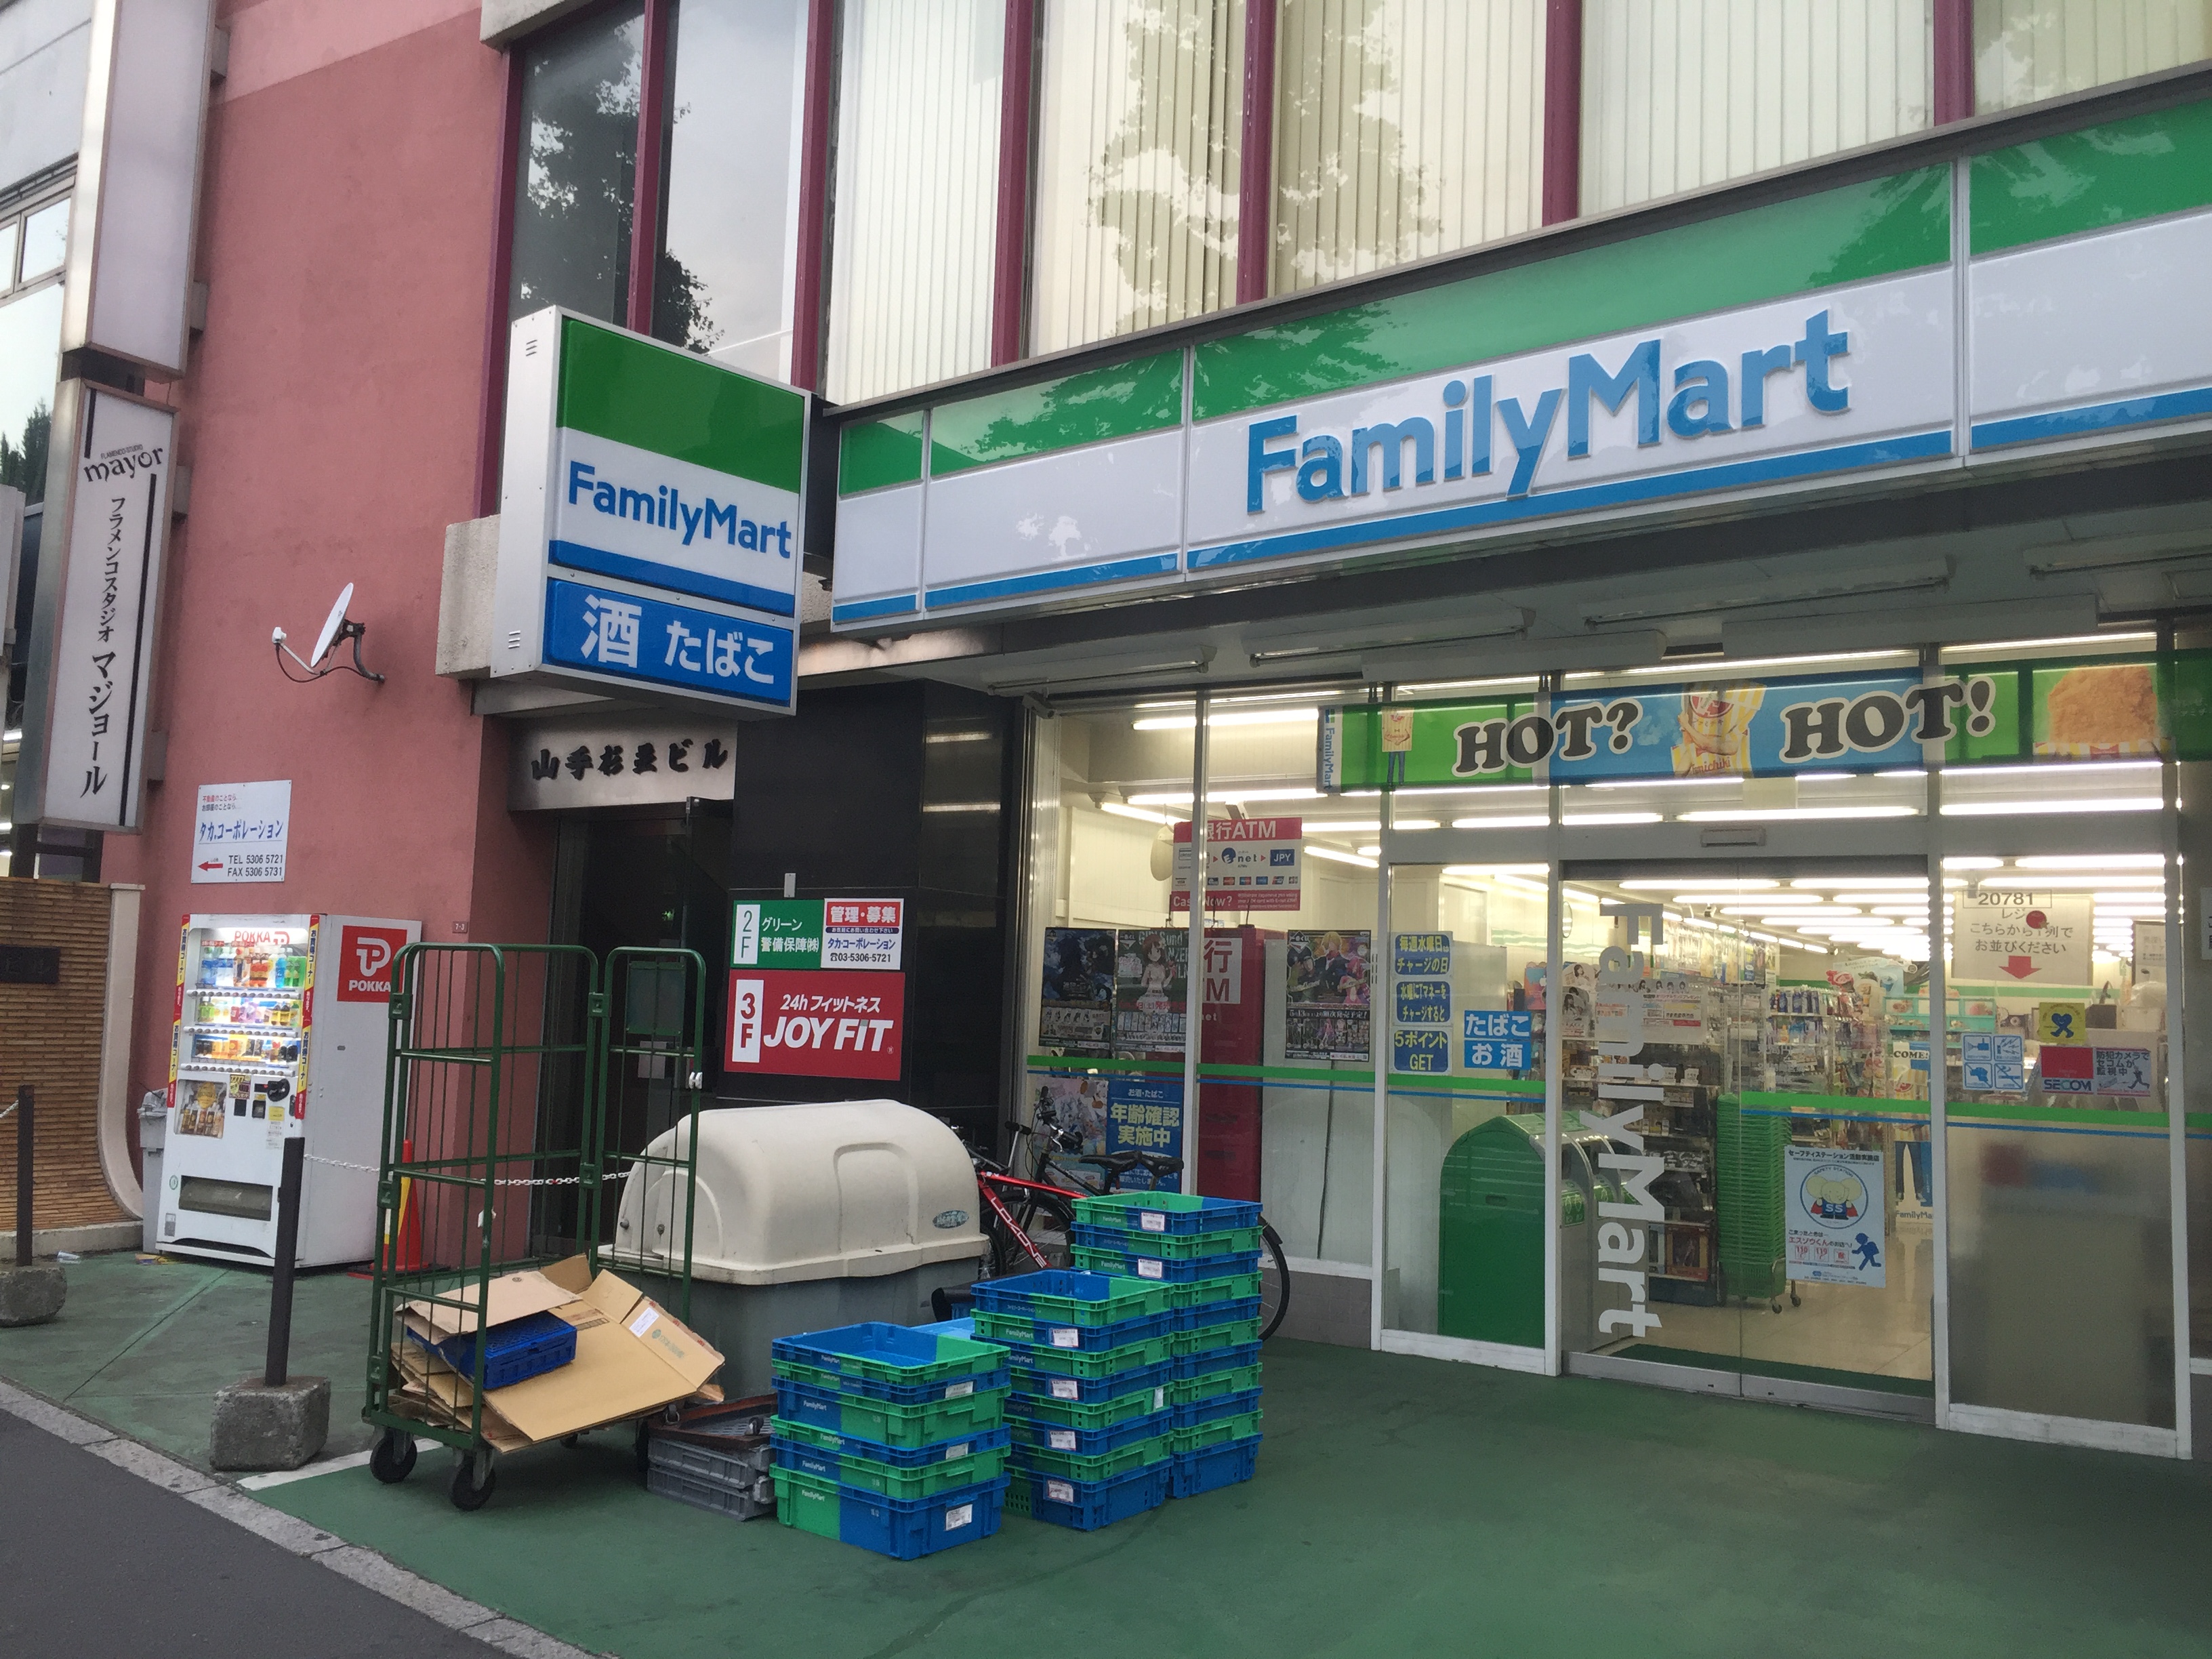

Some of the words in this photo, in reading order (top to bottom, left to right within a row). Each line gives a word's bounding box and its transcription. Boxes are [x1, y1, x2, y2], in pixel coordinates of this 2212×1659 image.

[1247, 309, 1849, 498] FamilyMart
[83, 448, 163, 482] mayor
[568, 460, 792, 558] FamilyMart
[97, 497, 127, 642] フラメンコスタジオ
[581, 594, 642, 668] 酒
[664, 620, 775, 684] たばこ
[80, 651, 117, 798] マジョール
[1784, 680, 1990, 758] HOT!
[1454, 703, 1640, 773] HOT?
[1324, 727, 1336, 790] FamilyMart
[229, 855, 243, 864] TEL
[246, 855, 263, 864] 5306
[266, 855, 283, 864] 5721
[1273, 853, 1291, 863] JPY
[228, 867, 243, 877] FAX
[245, 867, 263, 877] 5306
[264, 867, 282, 877] 5731
[1173, 896, 1191, 907] Cas
[1978, 892, 2034, 905] 20781
[830, 905, 897, 924] 管理・募集
[762, 917, 802, 931] グリーン
[234, 930, 270, 943] POKKA
[1975, 939, 2066, 954] お並びください
[838, 952, 891, 962] 03-5306-5721
[1204, 939, 1233, 973] 行
[1397, 958, 1448, 973] チャージの日
[348, 979, 391, 992] POKKA
[780, 994, 808, 1010] 24h
[811, 996, 882, 1013] フィットネス
[763, 1017, 835, 1048] JOY
[1465, 1014, 1530, 1037] たばこ
[1395, 1031, 1447, 1049] 5ポイント
[1410, 1054, 1434, 1071] GET
[1472, 1043, 1523, 1067] お酒
[1893, 1050, 1929, 1059] COME!
[2096, 1050, 2150, 1061] 防犯カメラで
[2097, 1059, 2135, 1068] セコムが
[2044, 1078, 2092, 1092] SECOM
[1110, 1103, 1180, 1127] 年齢確認
[1580, 903, 1665, 1338] FamilyMart
[1118, 1125, 1170, 1148] 実施中
[1825, 1203, 1843, 1213] SS
[1896, 1210, 1933, 1221] FamilyMa
[1008, 1355, 1033, 1364] amilyMart
